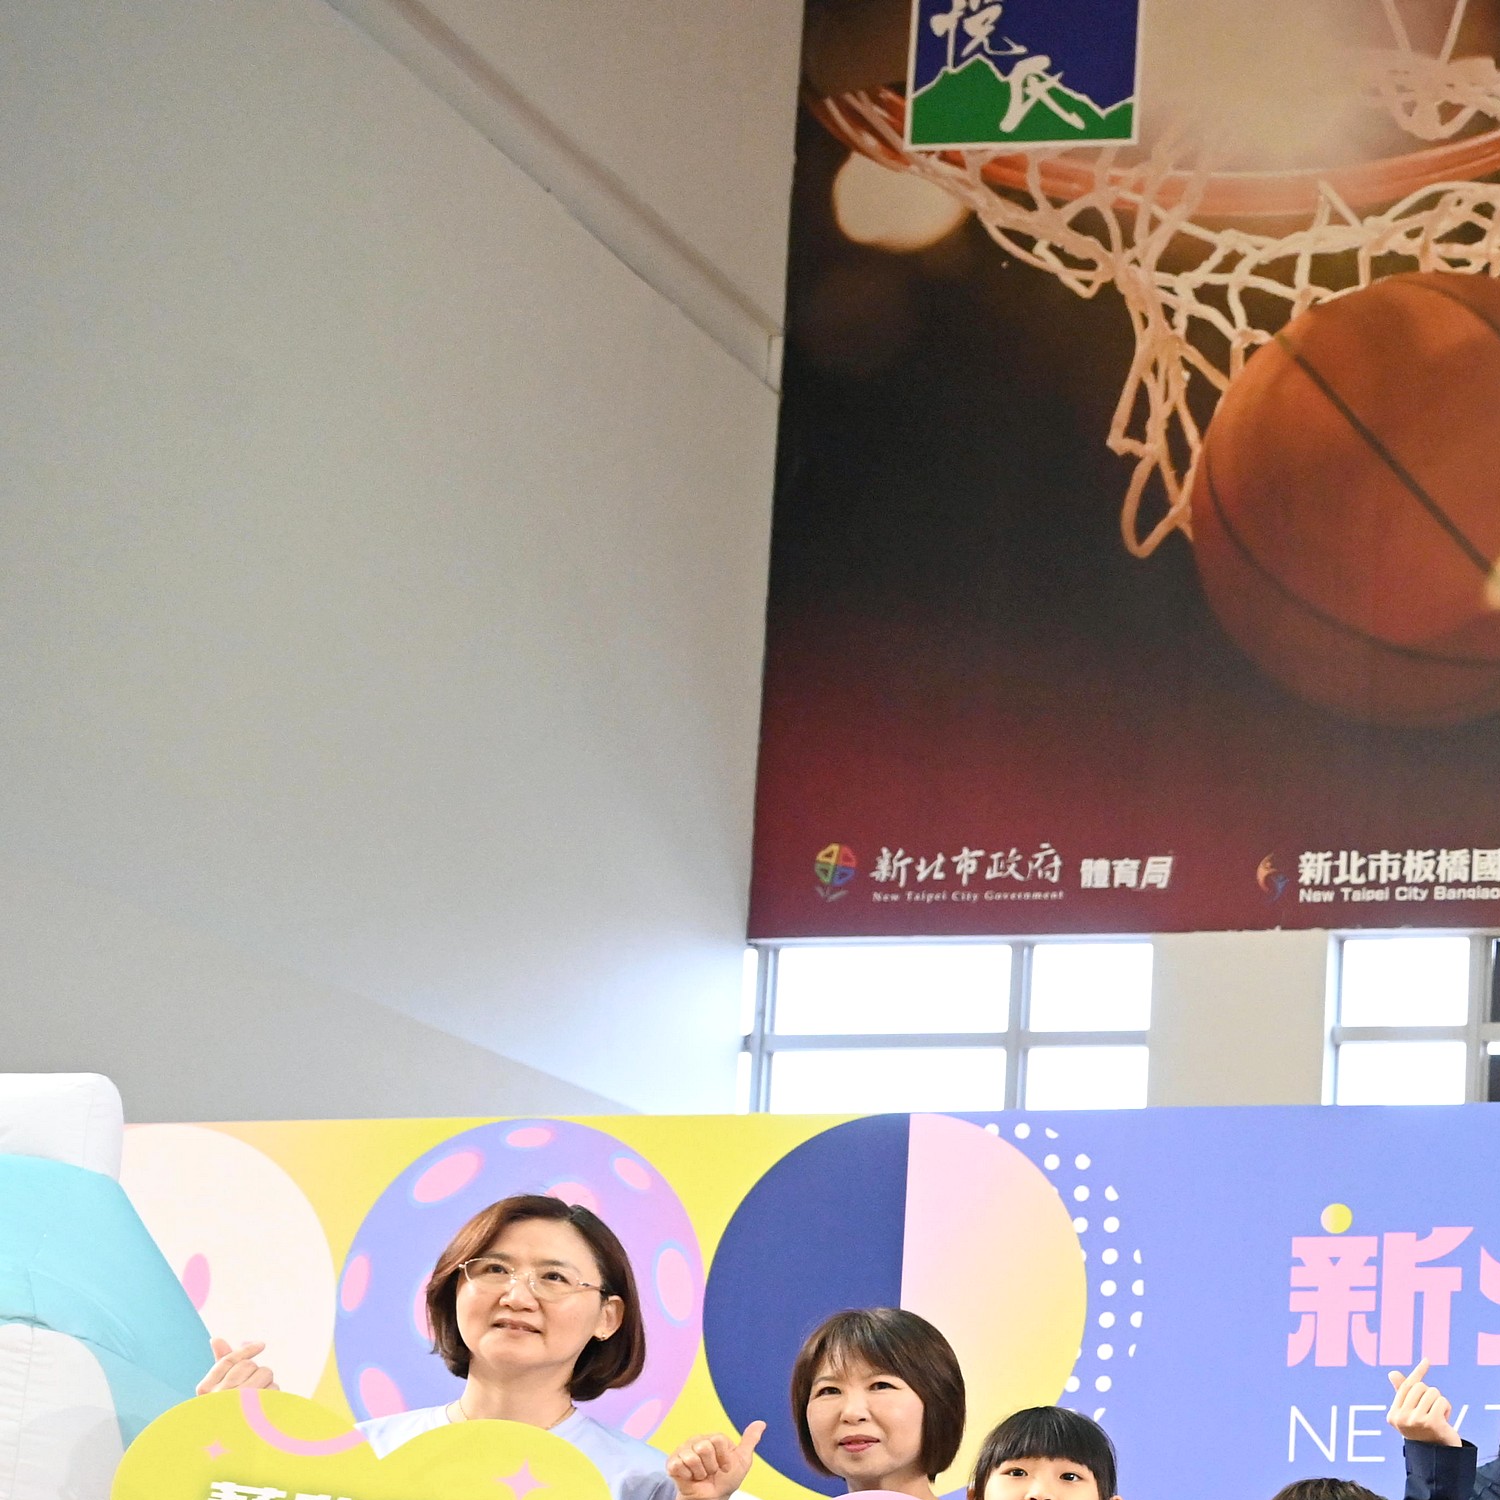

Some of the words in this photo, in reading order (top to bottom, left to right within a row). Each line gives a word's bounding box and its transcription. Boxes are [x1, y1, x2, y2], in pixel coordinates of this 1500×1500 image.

[869, 843, 1064, 888] 新北市政府
[1079, 854, 1175, 890] 體育局
[1299, 888, 1335, 903] New
[1340, 887, 1391, 903] Taipei
[1395, 886, 1430, 903] City
[1434, 886, 1500, 902] Banqiao
